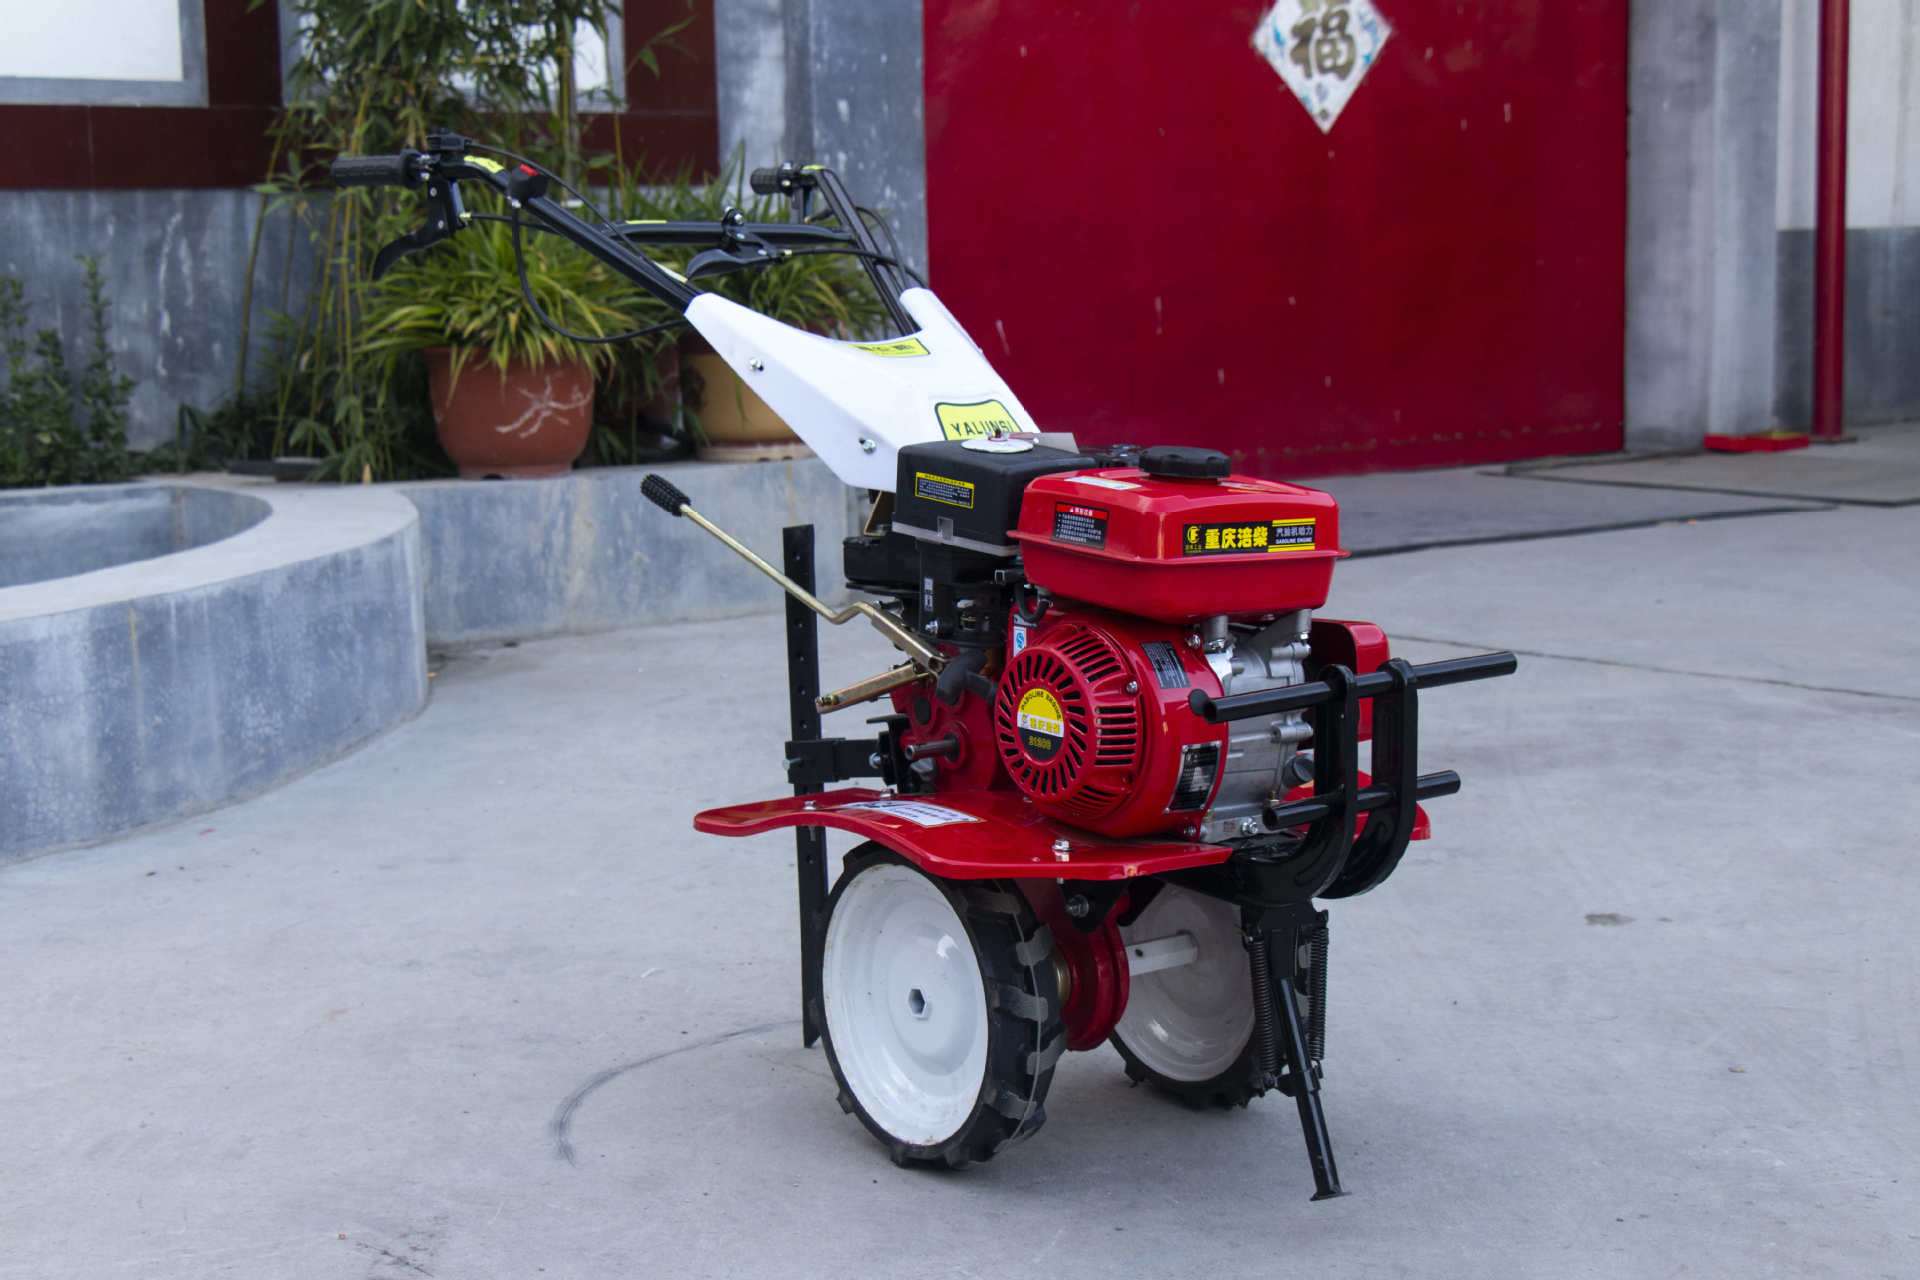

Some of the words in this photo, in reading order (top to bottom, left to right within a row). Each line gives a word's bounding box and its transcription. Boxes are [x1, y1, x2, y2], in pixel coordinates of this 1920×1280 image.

[1289, 3, 1356, 80] 福
[1204, 525, 1269, 549] 重庆涪柴
